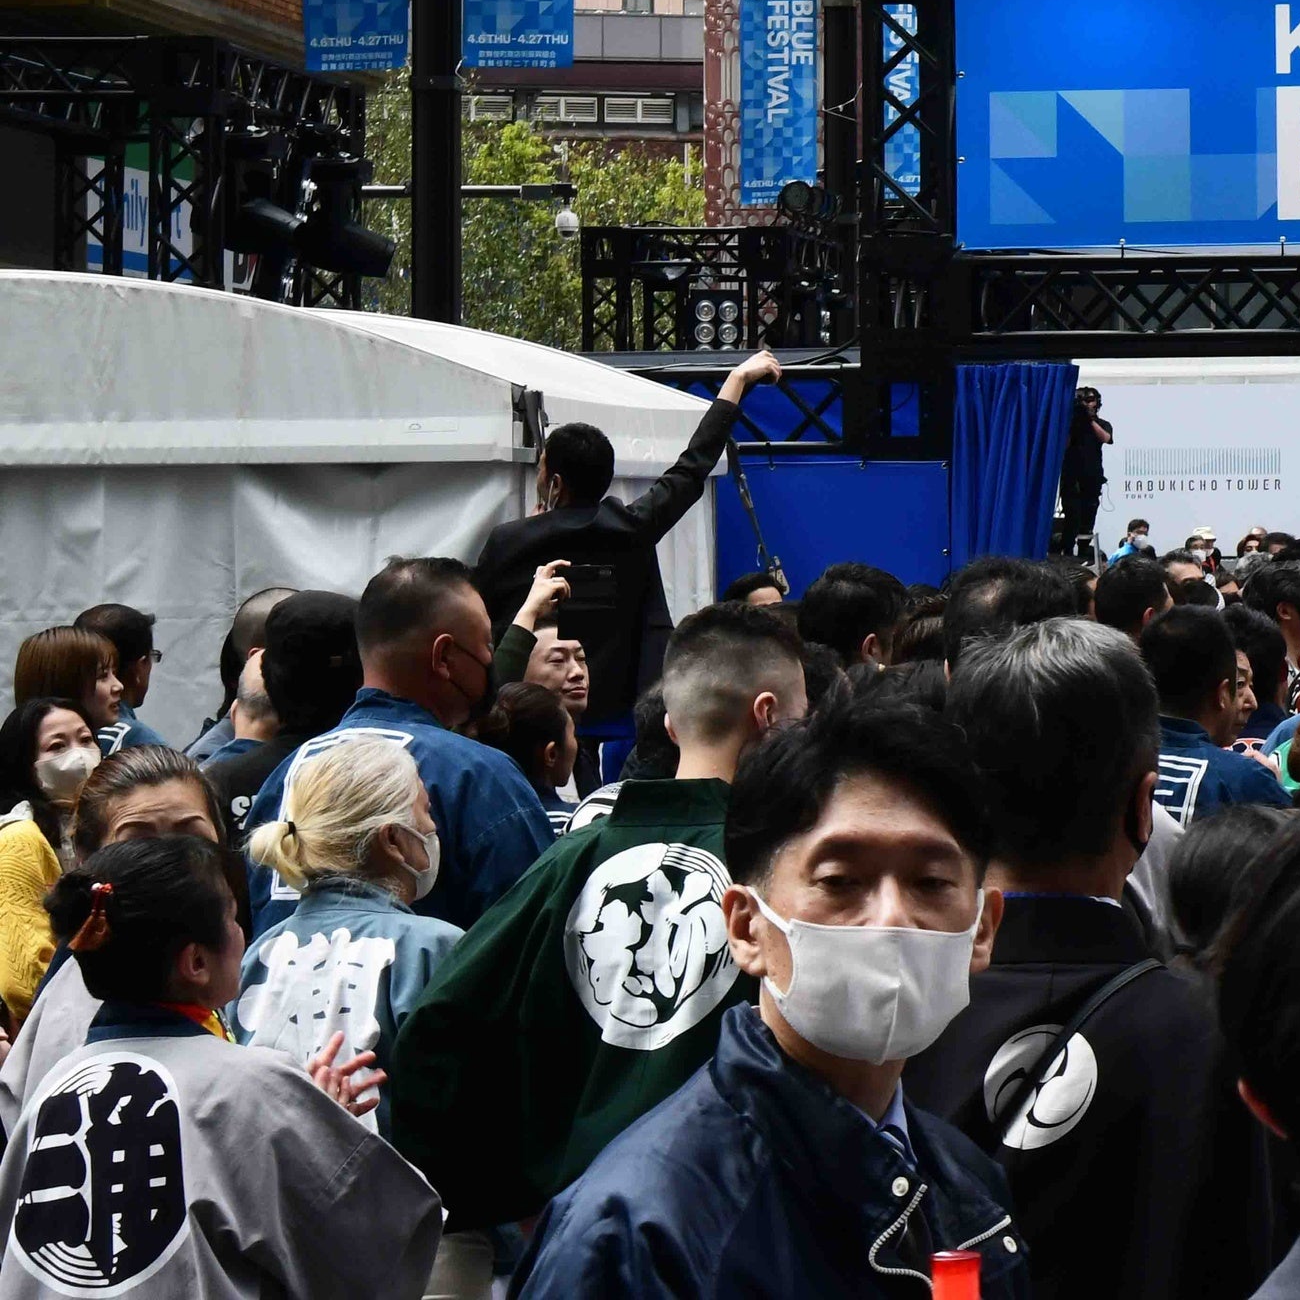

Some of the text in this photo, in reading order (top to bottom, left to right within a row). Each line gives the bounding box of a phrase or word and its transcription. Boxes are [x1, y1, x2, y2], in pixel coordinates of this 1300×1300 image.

[767, 0, 790, 123] FESTIVAL
[791, 0, 814, 66] BLUE
[1125, 479, 1281, 492] KABUKICHO TOWER
